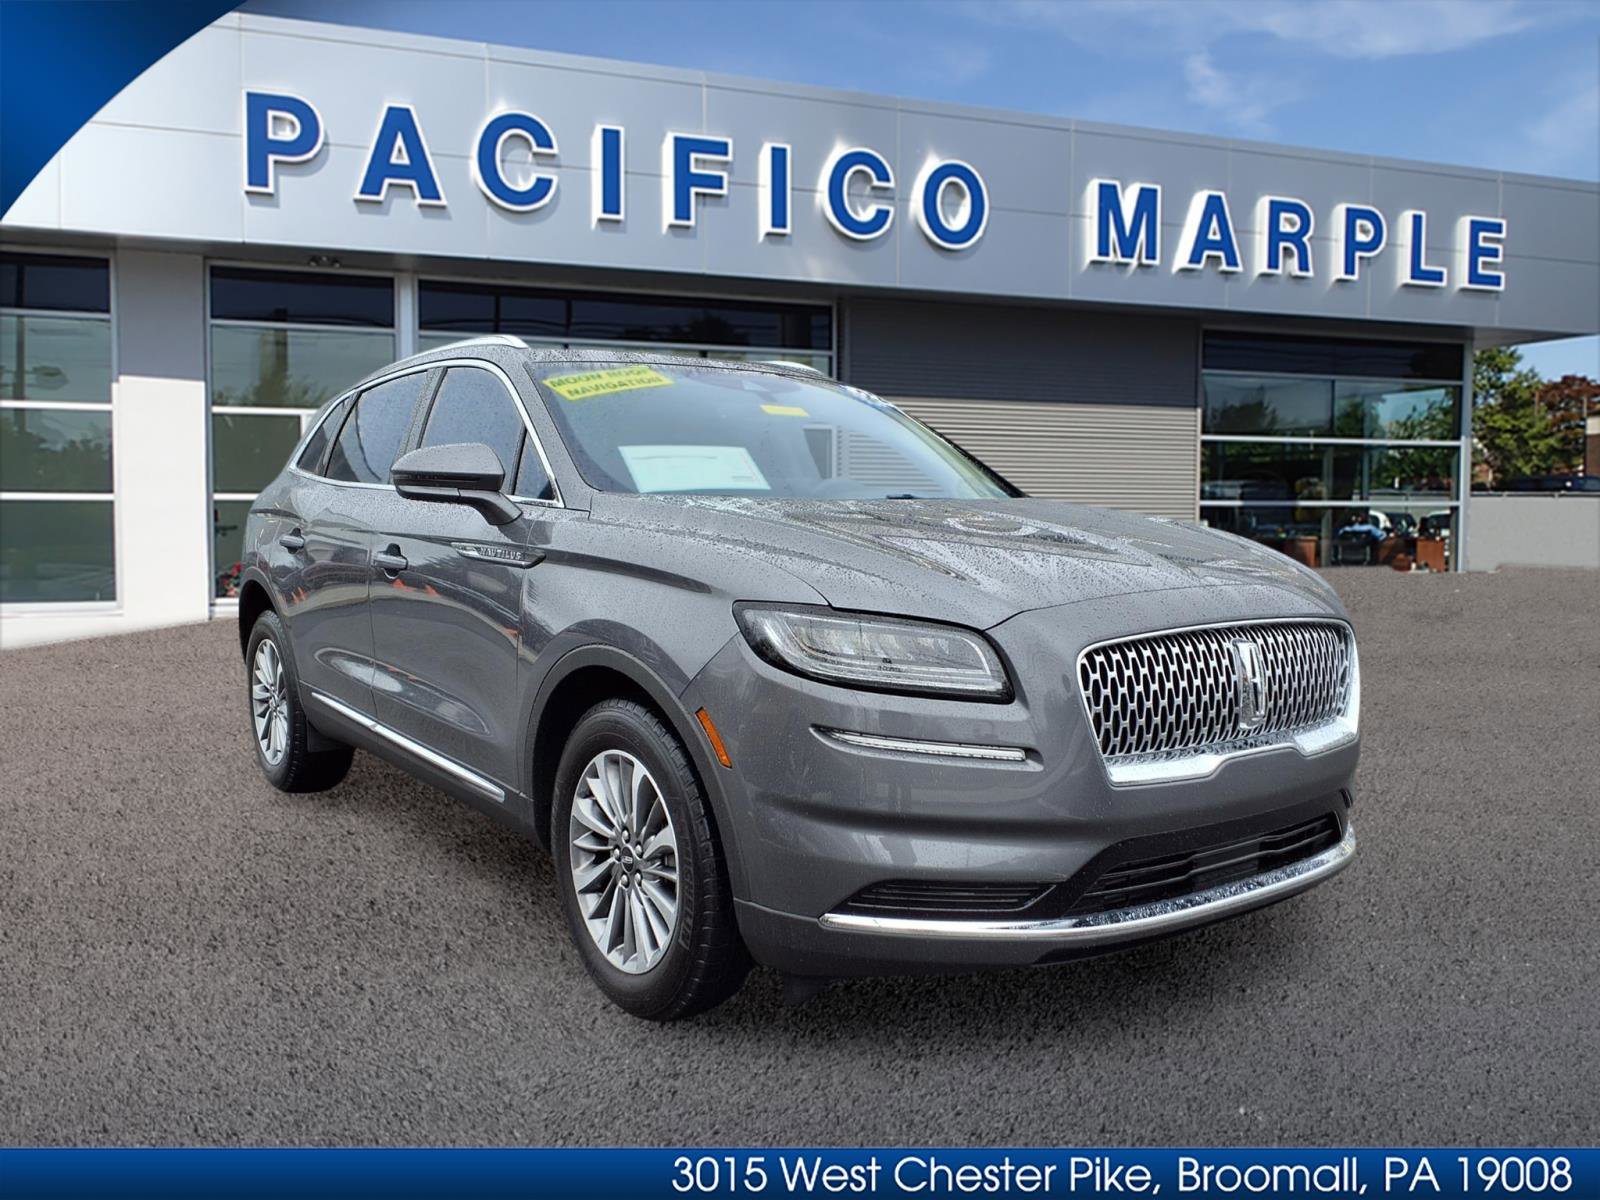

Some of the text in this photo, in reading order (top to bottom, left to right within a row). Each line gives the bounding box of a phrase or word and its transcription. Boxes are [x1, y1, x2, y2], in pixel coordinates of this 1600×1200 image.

[242, 89, 1507, 292] PACIFICO MARPLE
[549, 372, 602, 388] MOON
[566, 376, 663, 397] NAVIGATION
[480, 546, 521, 560] NAUTILUS
